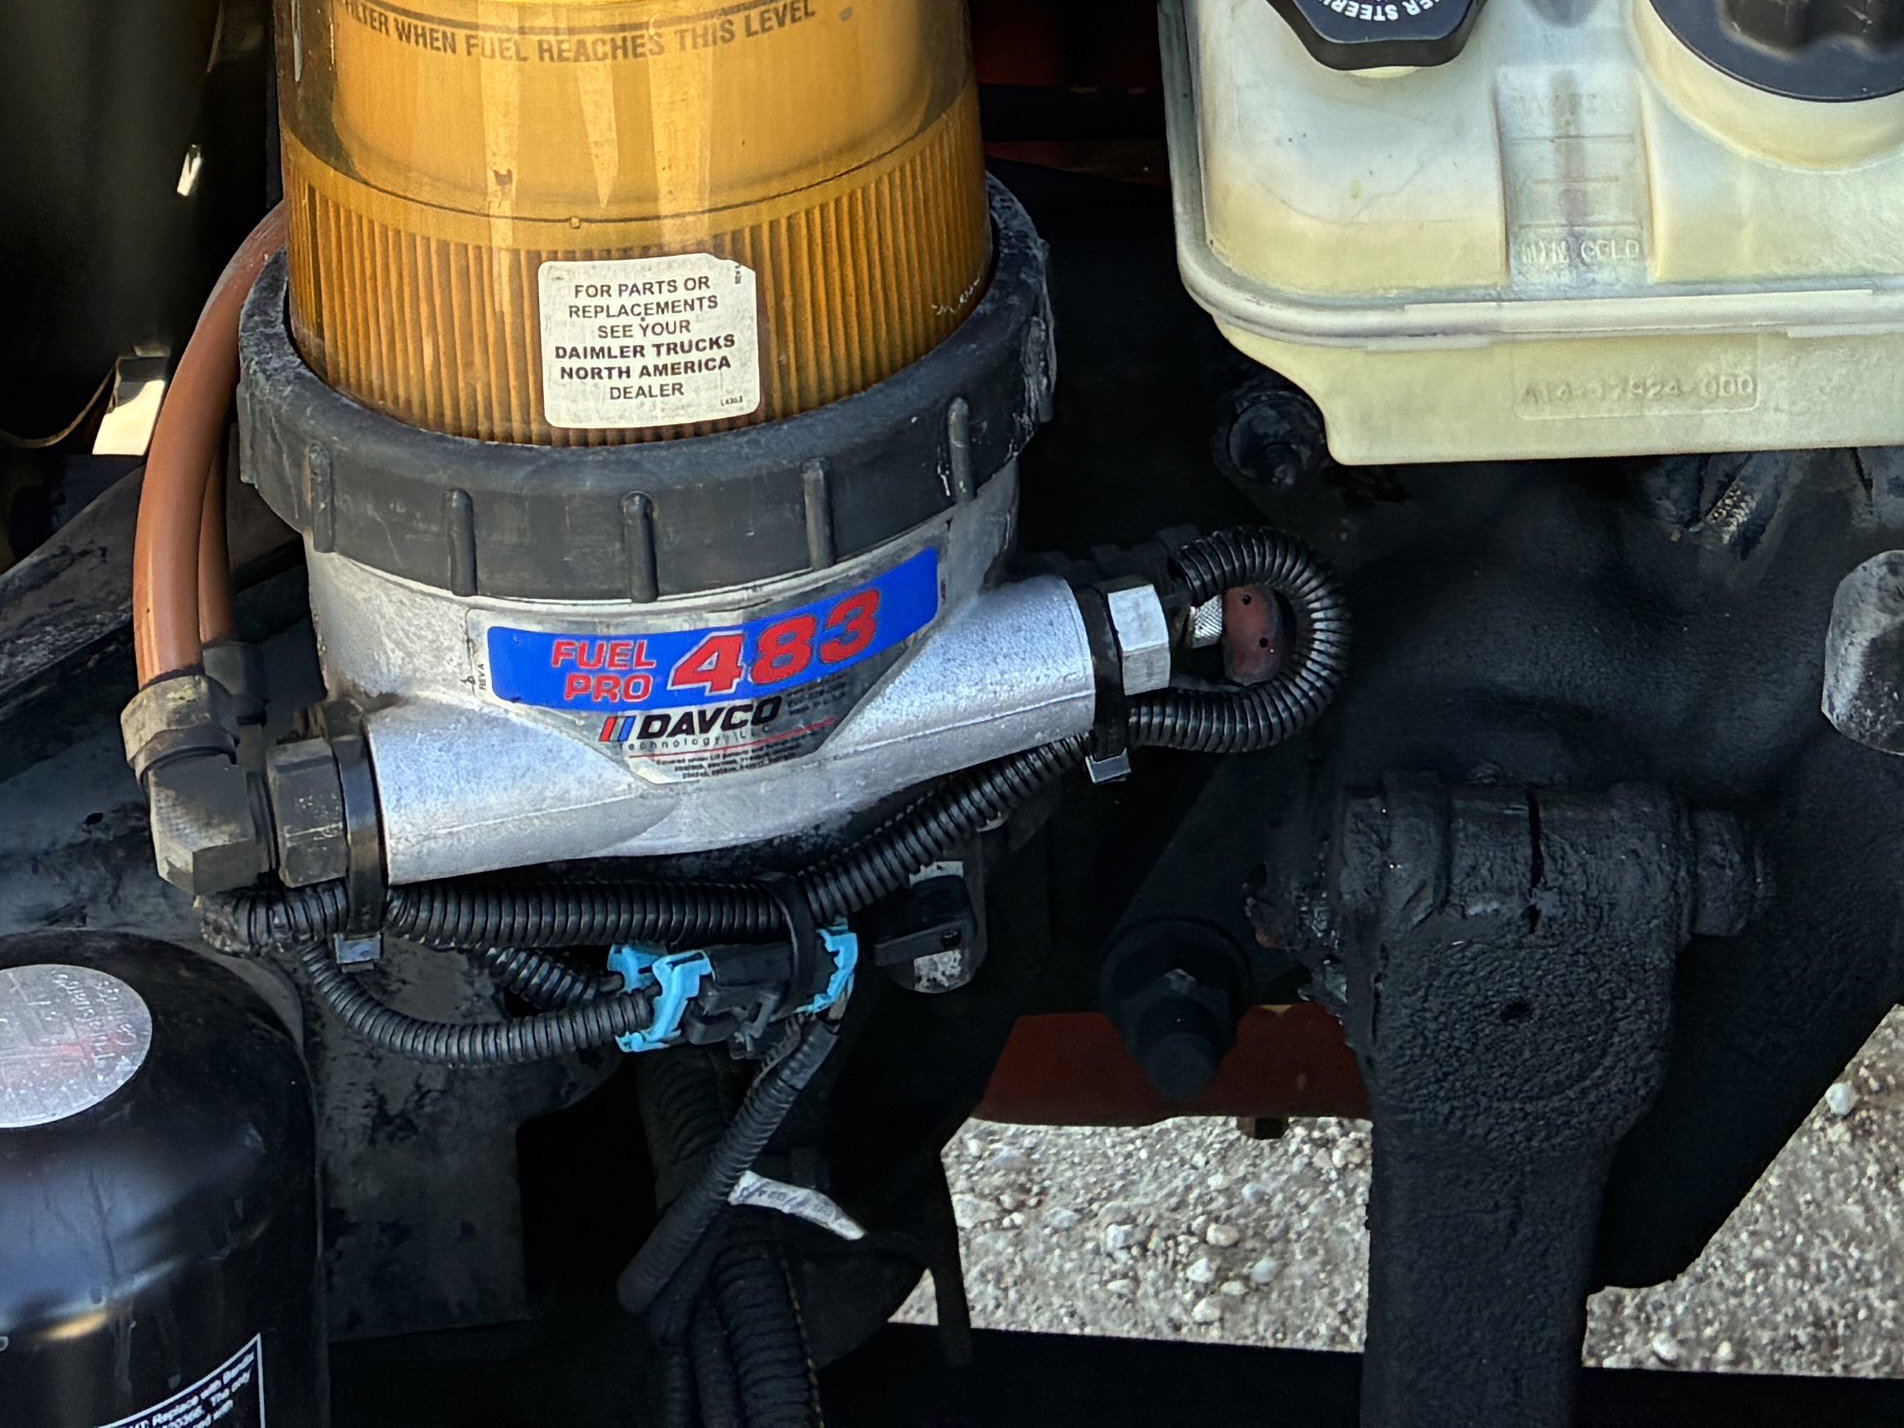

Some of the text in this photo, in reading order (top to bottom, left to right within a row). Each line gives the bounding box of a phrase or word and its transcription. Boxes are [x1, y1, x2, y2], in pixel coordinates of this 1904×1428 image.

[394, 13, 457, 55] WHEN
[465, 33, 529, 63] FUEL
[538, 30, 665, 64] REACHES
[676, 15, 737, 52] THIS
[574, 275, 711, 300] FOR PARTS OR
[568, 293, 719, 321] REPLACEMENTS
[597, 318, 692, 340] SEE YOUR
[555, 333, 736, 362] DAIMLER TRUCKS
[559, 355, 732, 382] NORTH AMERICA
[609, 381, 685, 401] DEALER
[550, 639, 657, 670] FUEL
[666, 587, 882, 694] 483
[563, 672, 654, 704] PRO
[636, 694, 782, 742] DAVCO
[153, 1396, 199, 1427] Replace
